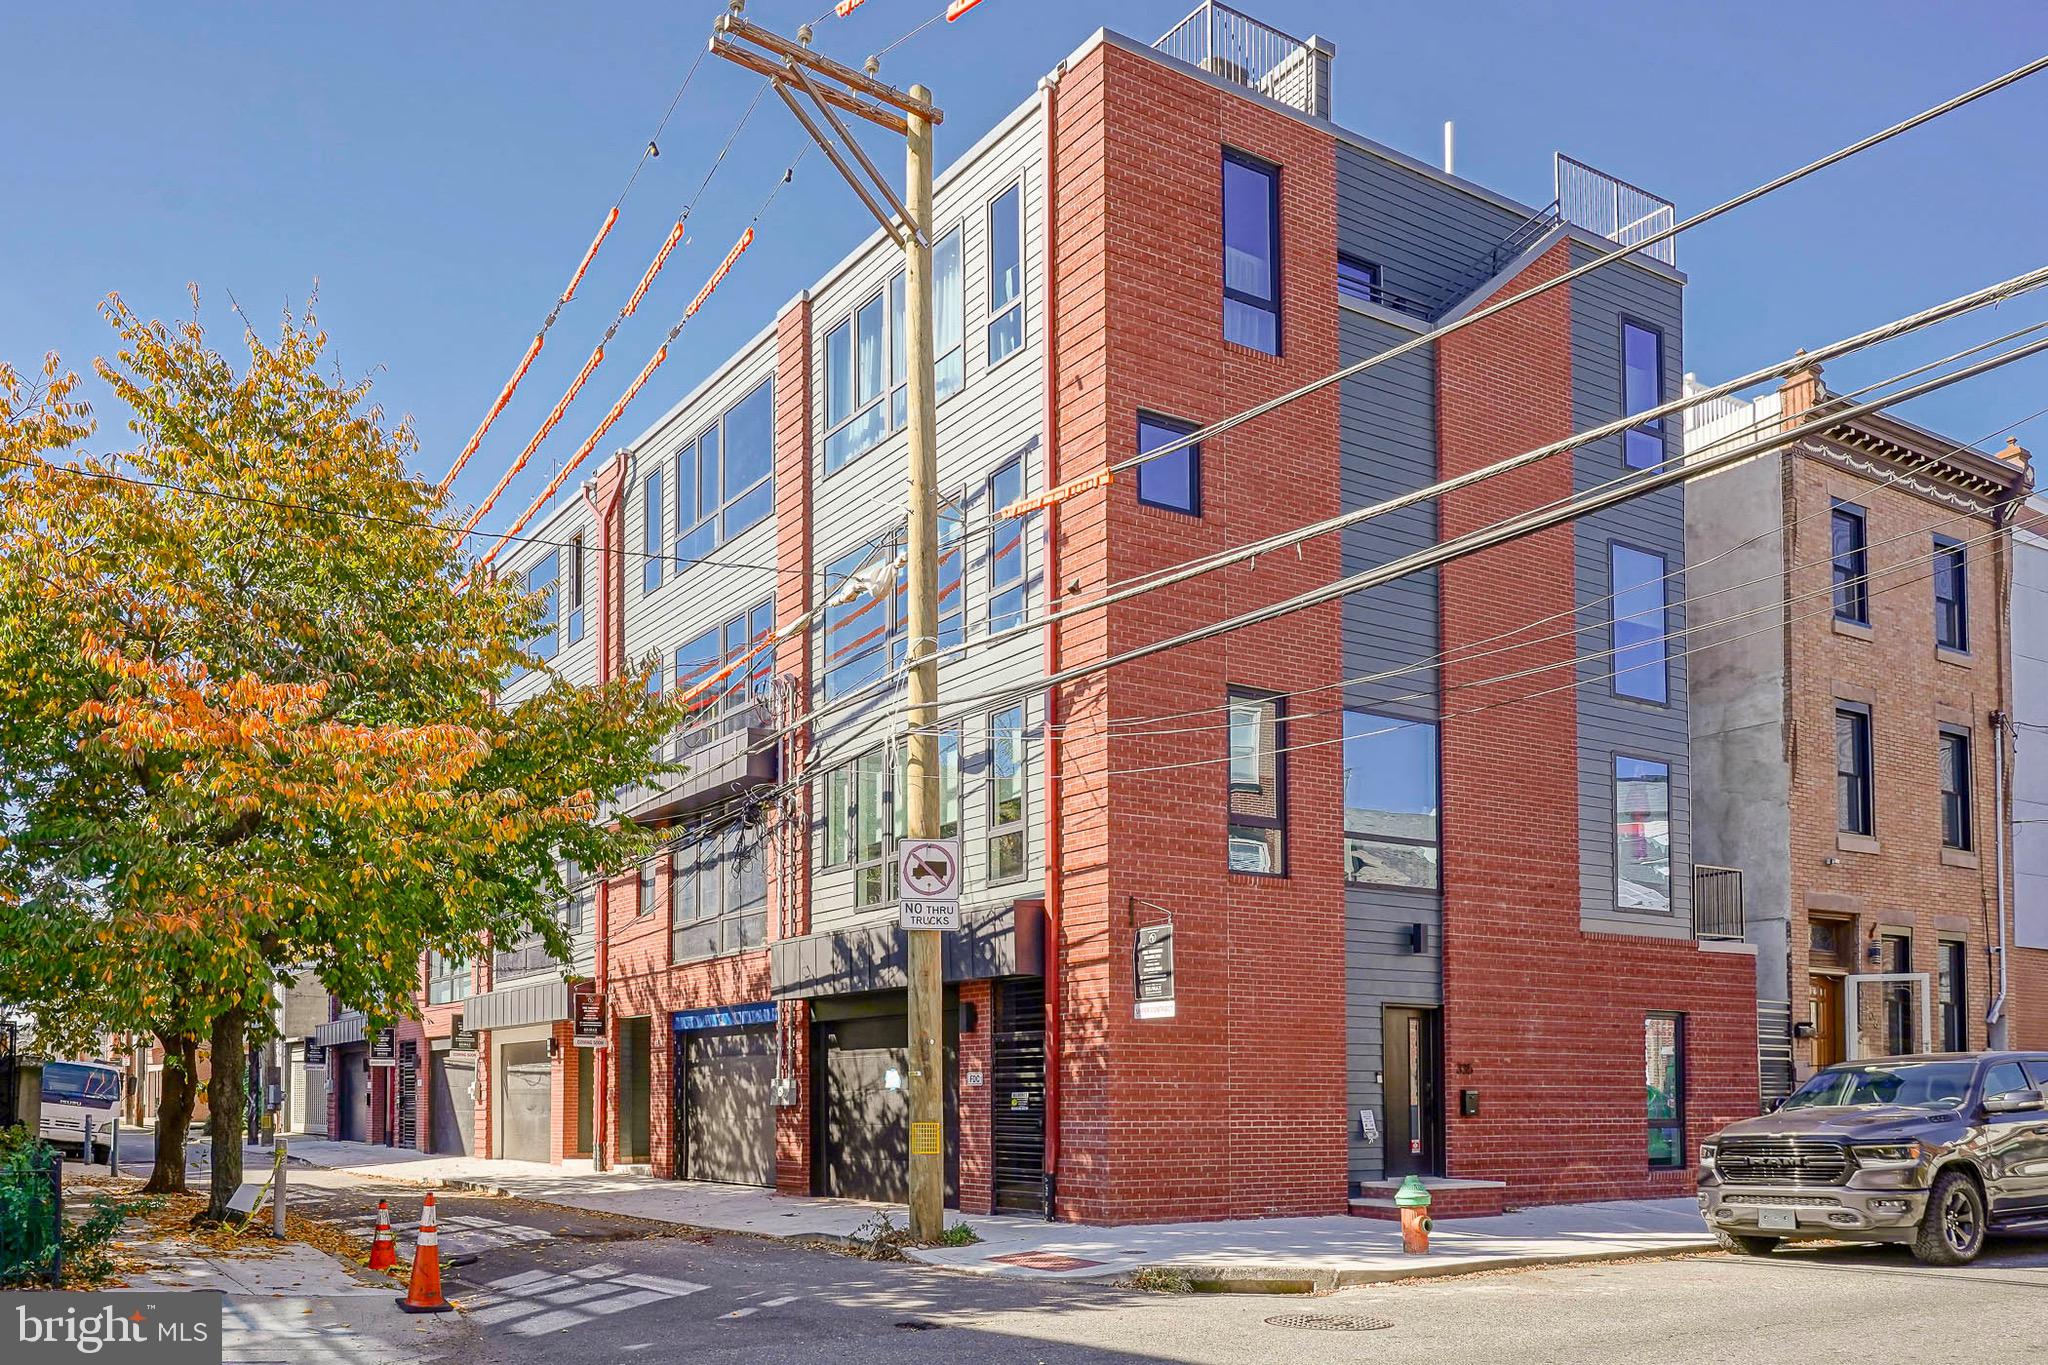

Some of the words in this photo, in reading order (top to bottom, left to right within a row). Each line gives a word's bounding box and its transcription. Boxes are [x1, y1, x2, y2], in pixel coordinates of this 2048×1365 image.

[905, 903, 922, 914] NO
[926, 906, 954, 914] THRU
[910, 916, 950, 925] TRUCKS
[1749, 1156, 1802, 1167] RAM
